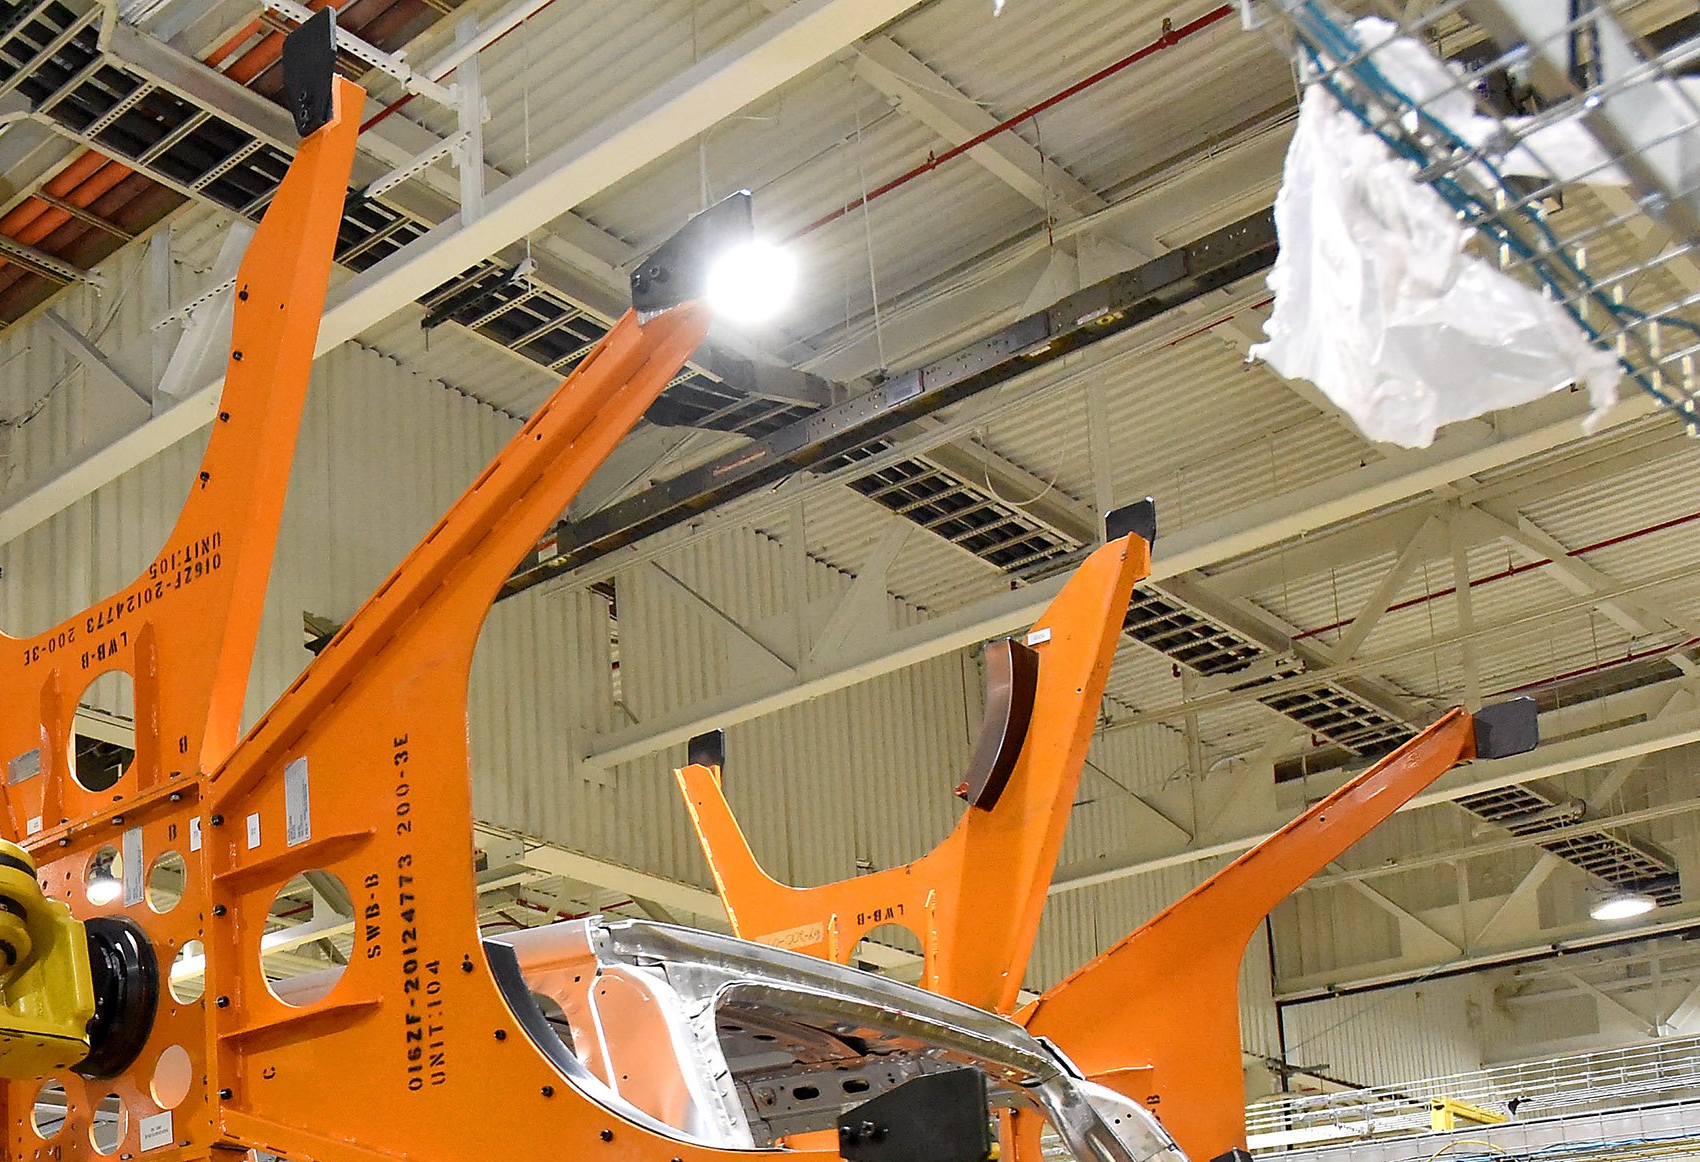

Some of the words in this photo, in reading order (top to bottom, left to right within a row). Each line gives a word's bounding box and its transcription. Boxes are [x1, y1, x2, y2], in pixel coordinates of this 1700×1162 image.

[87, 552, 221, 635] 016ZF-20124773
[150, 531, 221, 580] UNIT:105
[24, 626, 76, 667] 200-3E
[81, 631, 128, 669] LWB-B
[393, 733, 412, 836] 200-3E
[364, 873, 381, 959] SWB-B
[397, 854, 424, 1091] 016ZF-20124773
[425, 960, 446, 1087] UNIT:104
